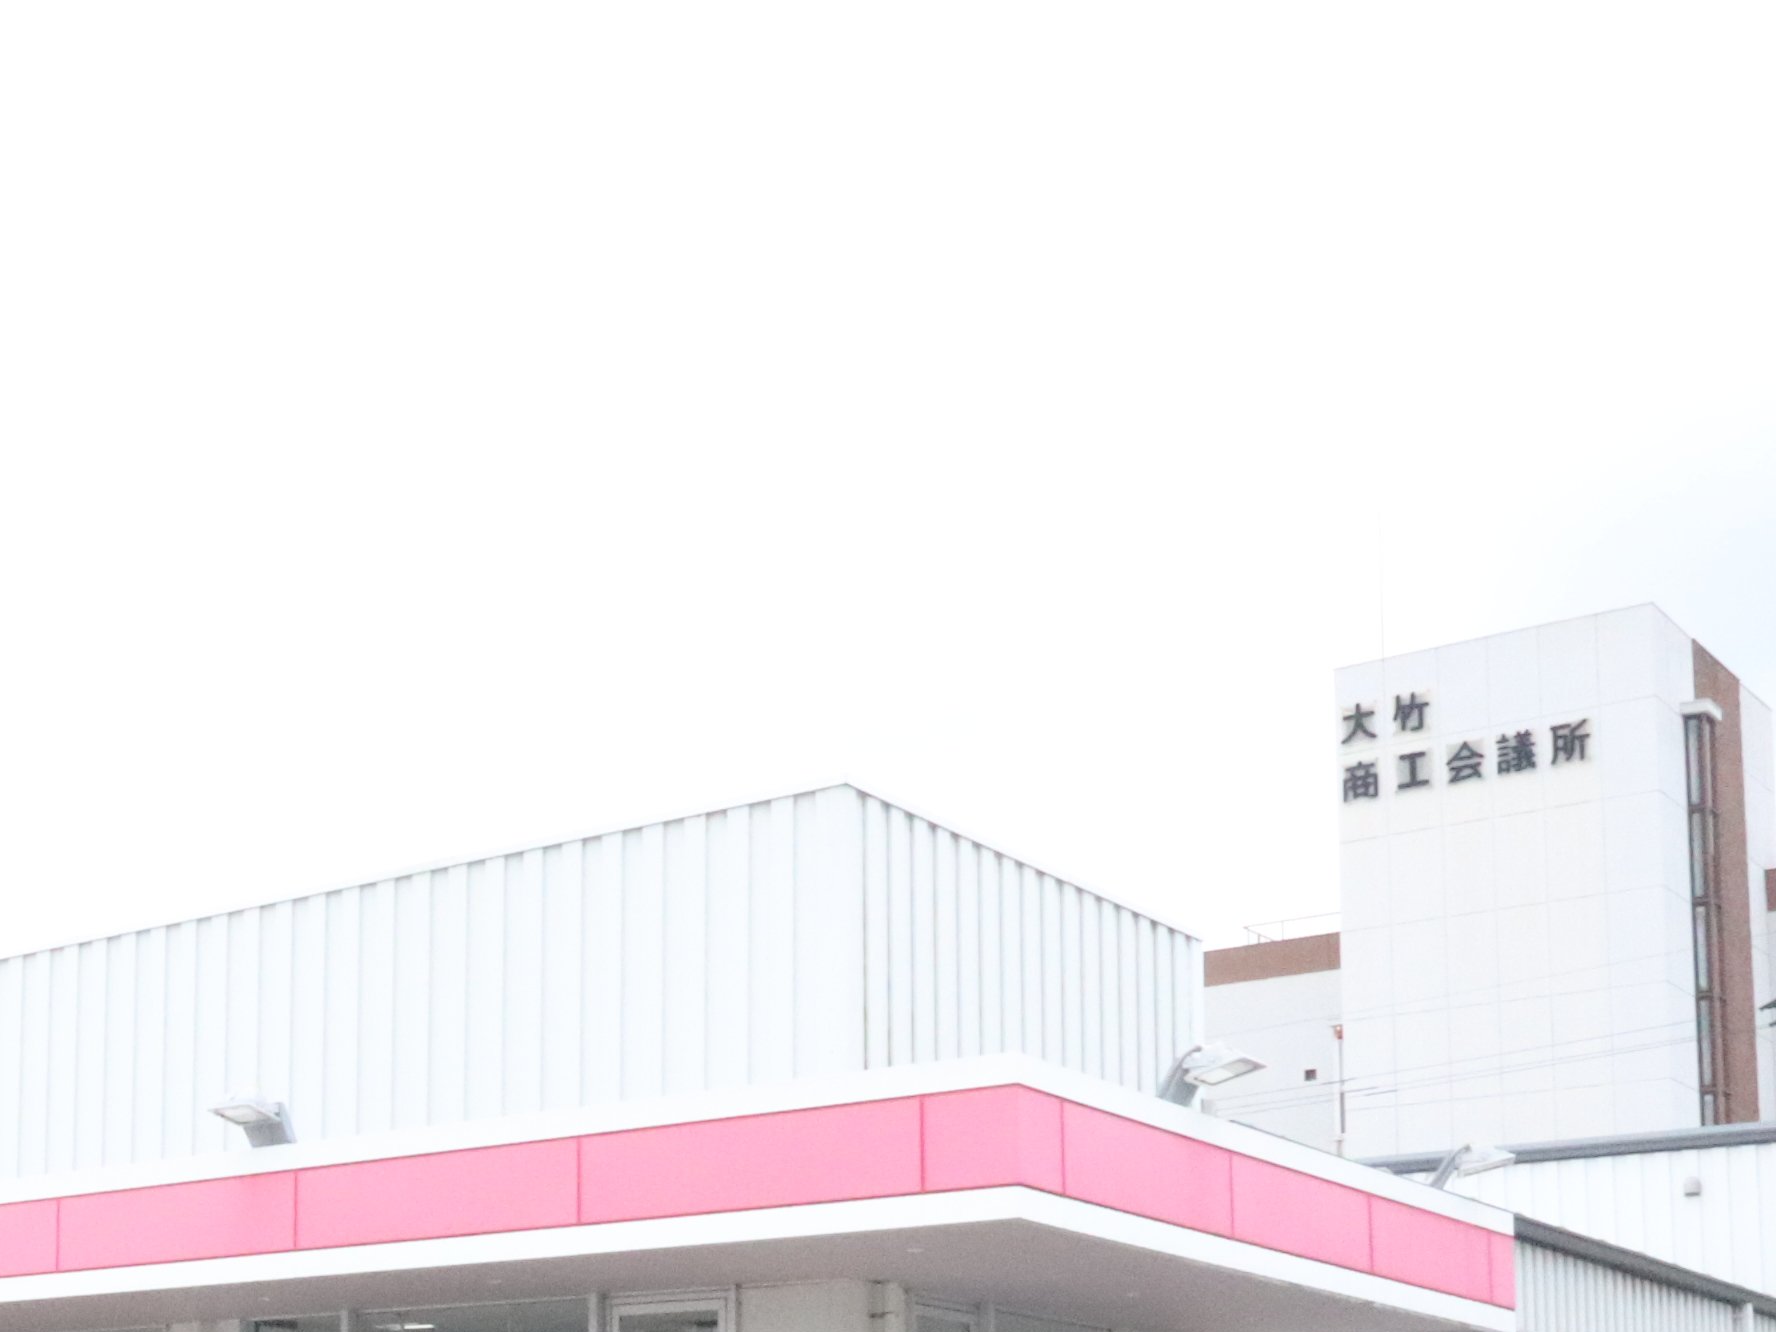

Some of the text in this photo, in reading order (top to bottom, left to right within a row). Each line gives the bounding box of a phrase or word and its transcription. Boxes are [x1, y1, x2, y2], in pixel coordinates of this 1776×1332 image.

[1341, 692, 1430, 745] 大竹
[1342, 718, 1592, 803] 商工会議所
